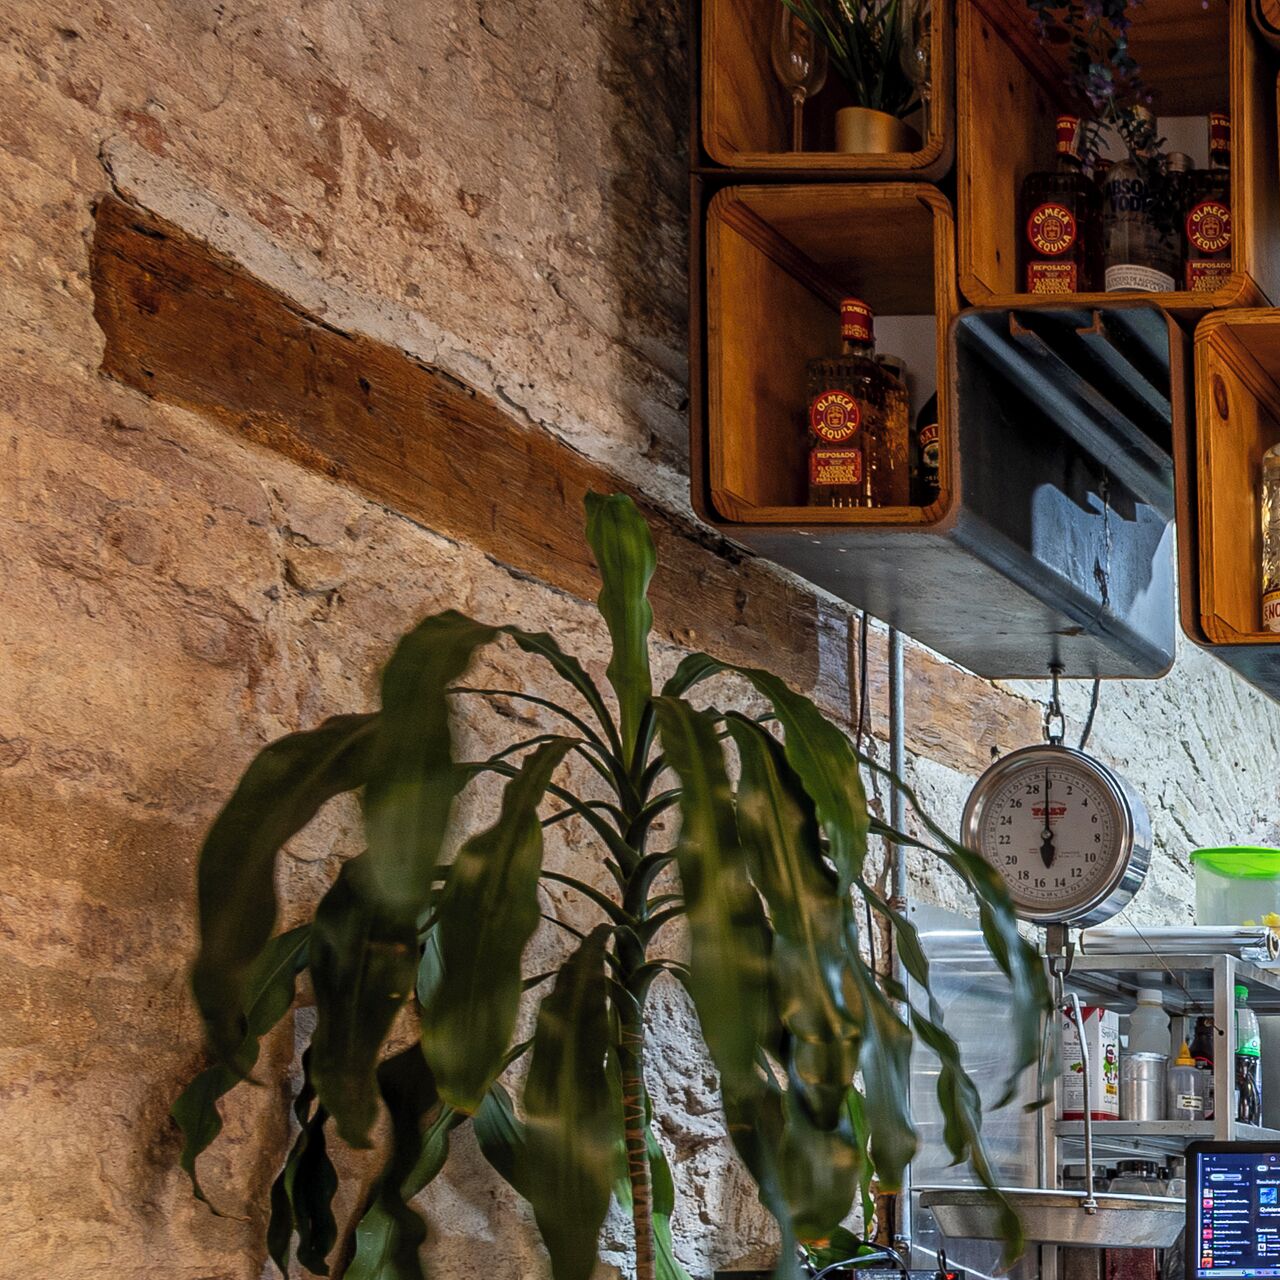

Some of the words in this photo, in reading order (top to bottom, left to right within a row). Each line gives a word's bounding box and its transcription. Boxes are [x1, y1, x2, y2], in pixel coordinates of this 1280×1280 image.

[1033, 207, 1070, 225] OLMECA
[1192, 205, 1229, 222] OLMECA
[1033, 234, 1072, 252] TEQUILA
[1193, 232, 1231, 250] TEQUILA
[816, 394, 853, 412] OLMECA
[816, 421, 856, 440] TEQUILA
[816, 452, 856, 460] REPOSADO
[1025, 784, 1040, 795] 28
[1066, 786, 1073, 795] 2
[1010, 798, 1022, 808] 26
[1081, 798, 1088, 807] 4
[1000, 816, 1012, 825] 24
[1091, 814, 1098, 823] 6
[999, 835, 1010, 845] 22
[1094, 833, 1101, 843] 8
[1005, 855, 1018, 865] 20
[1084, 853, 1096, 862] 10
[1017, 870, 1029, 880] 18
[1071, 868, 1082, 878] 12
[1034, 878, 1046, 888] 16
[1054, 878, 1066, 887] 14
